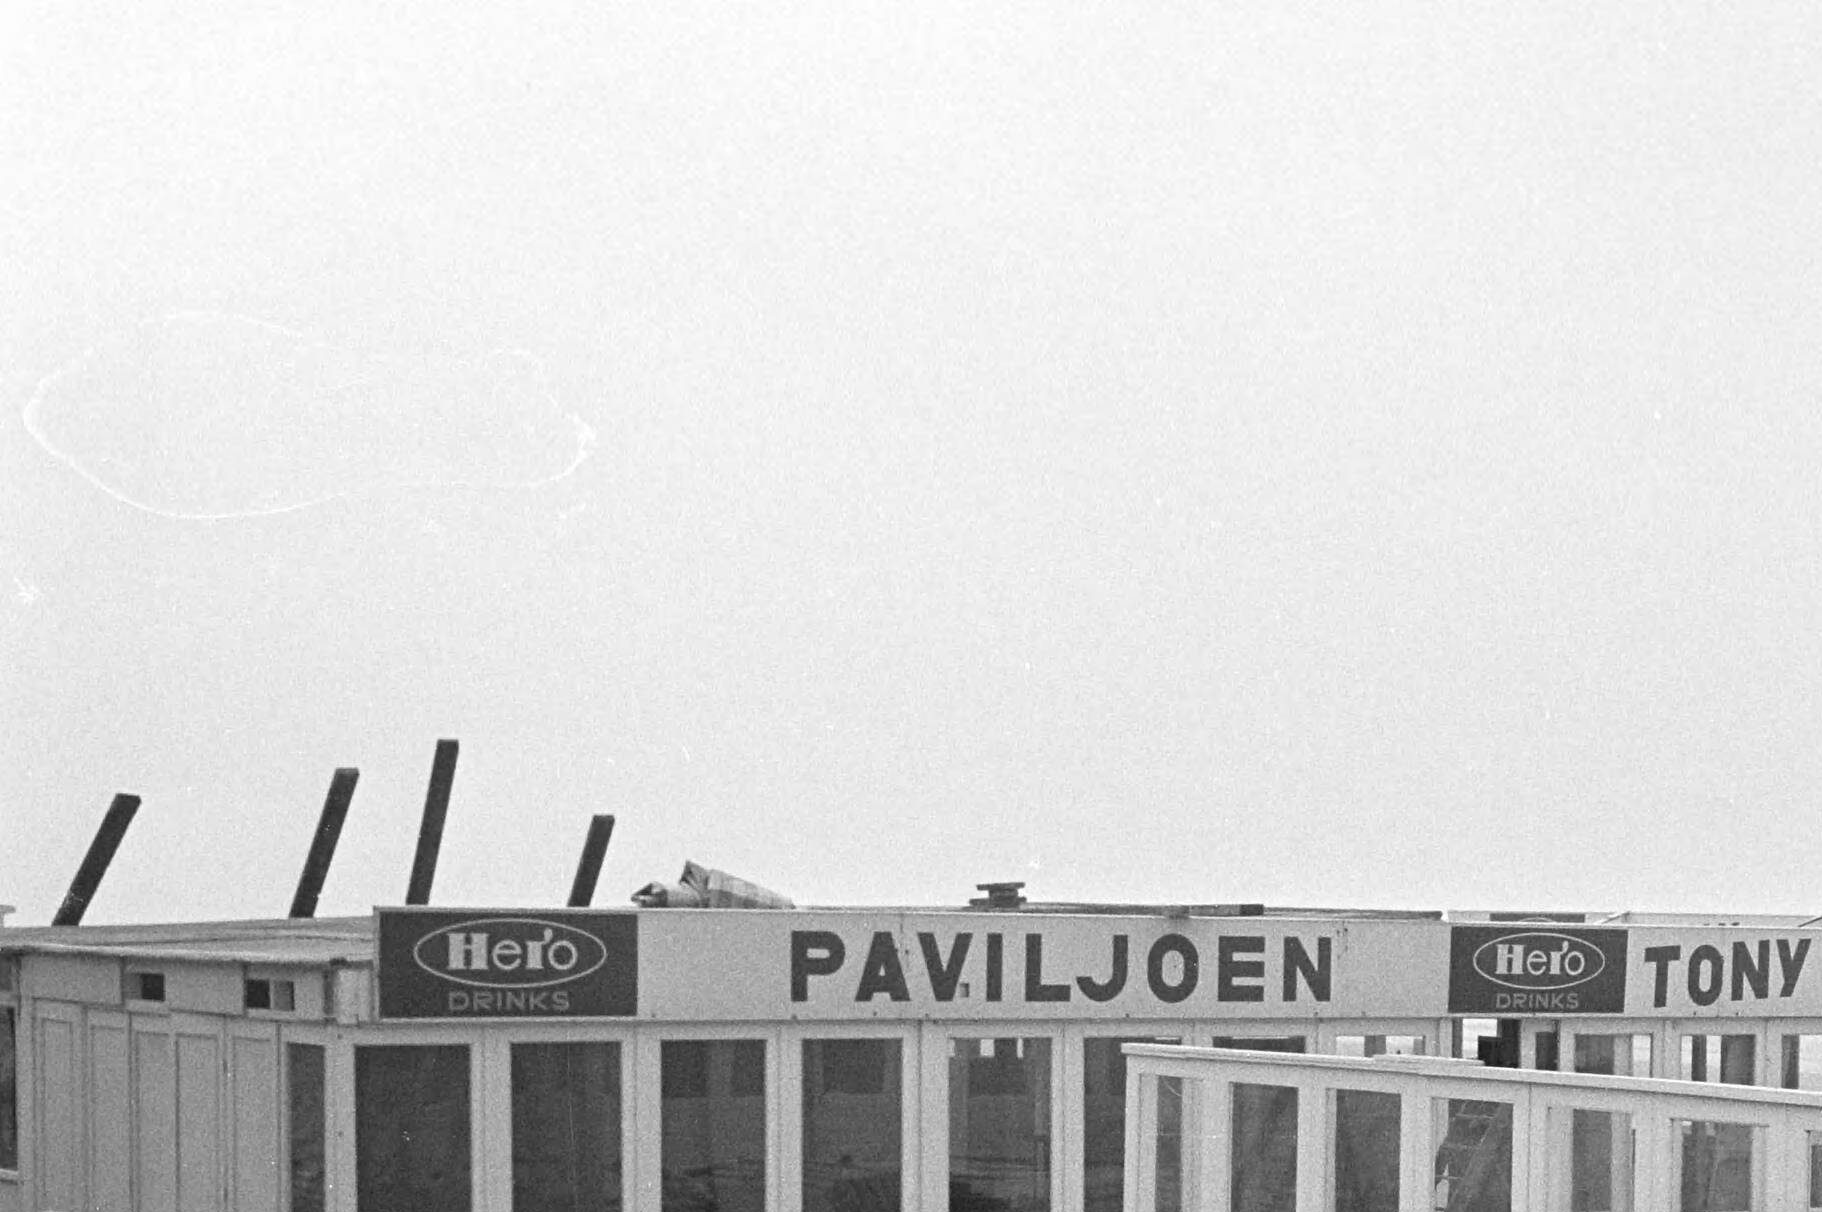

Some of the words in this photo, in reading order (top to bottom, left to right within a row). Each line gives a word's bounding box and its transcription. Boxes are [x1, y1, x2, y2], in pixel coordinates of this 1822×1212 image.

[448, 928, 578, 972] Hero
[790, 929, 1333, 1004] PAVILJOEN
[1495, 940, 1586, 976] Hero
[1644, 938, 1811, 1008] TONY
[448, 990, 570, 1012] DRINKS
[1494, 992, 1580, 1010] DRINKS
